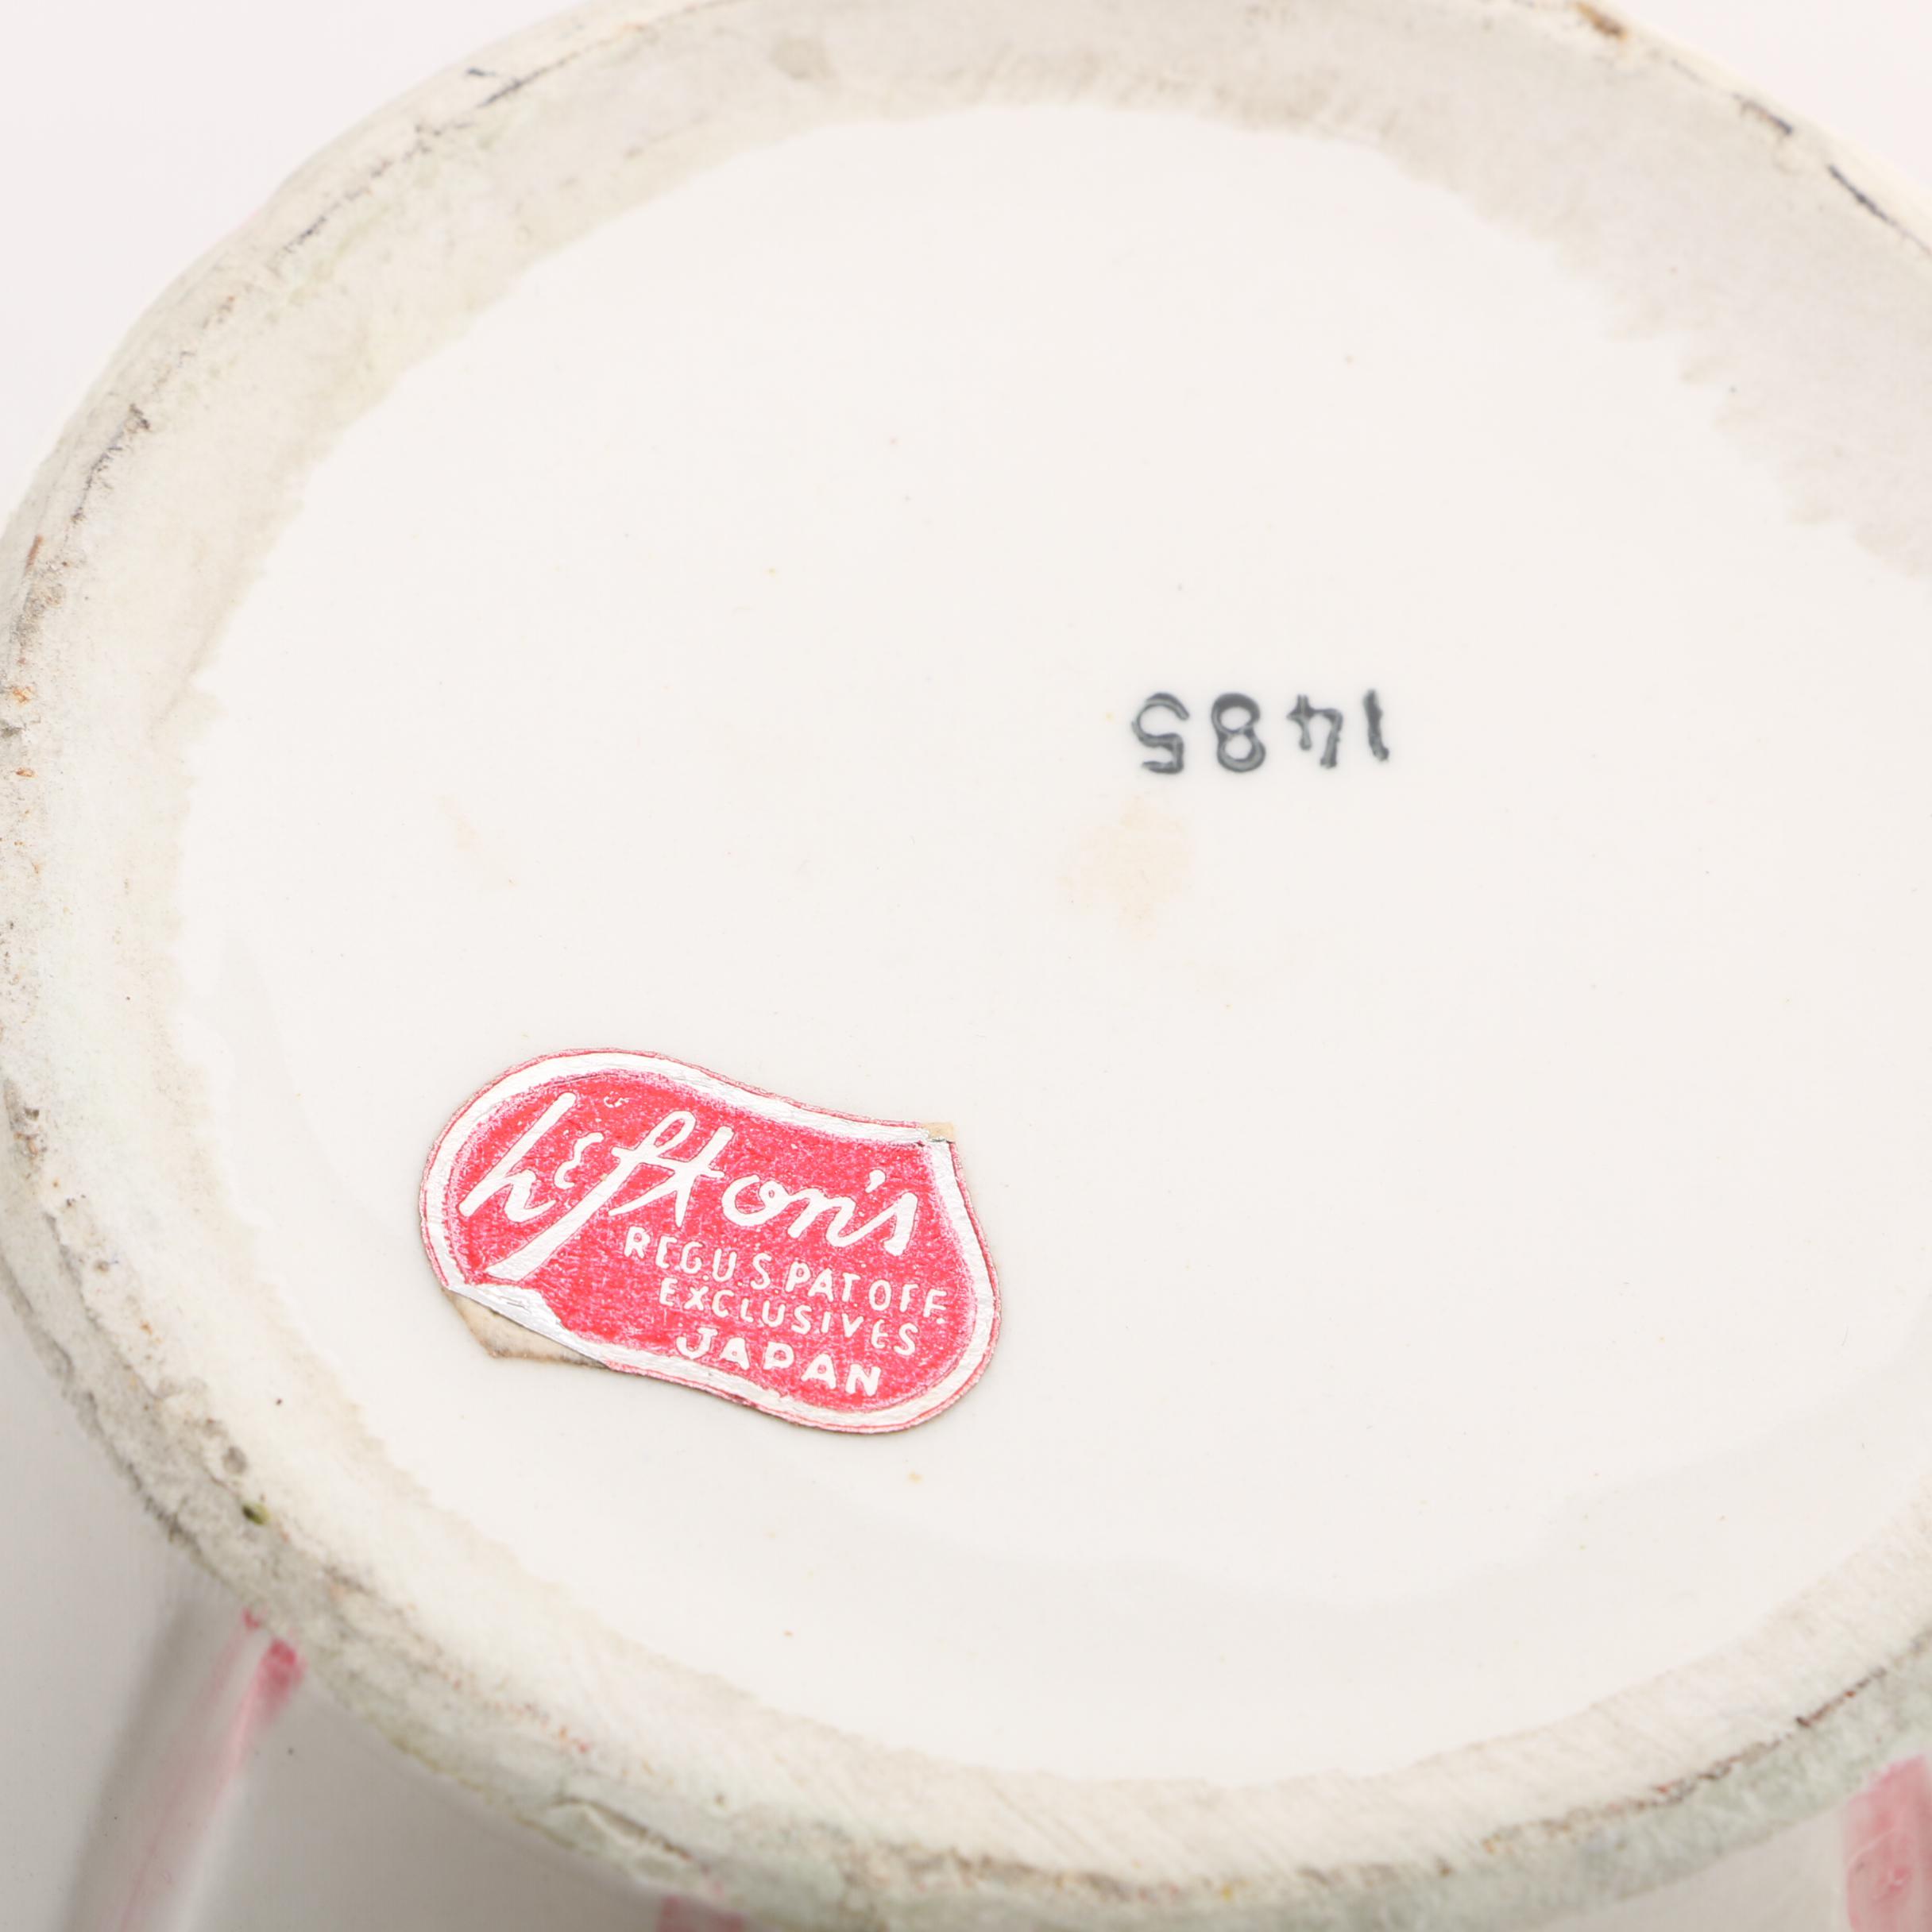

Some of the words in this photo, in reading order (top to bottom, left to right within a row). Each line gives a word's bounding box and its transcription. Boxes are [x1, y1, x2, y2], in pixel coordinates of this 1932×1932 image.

[1131, 688, 1390, 775] 1485
[658, 1277, 920, 1356] EXCLUSIVES
[675, 1326, 883, 1397] JAPAN
